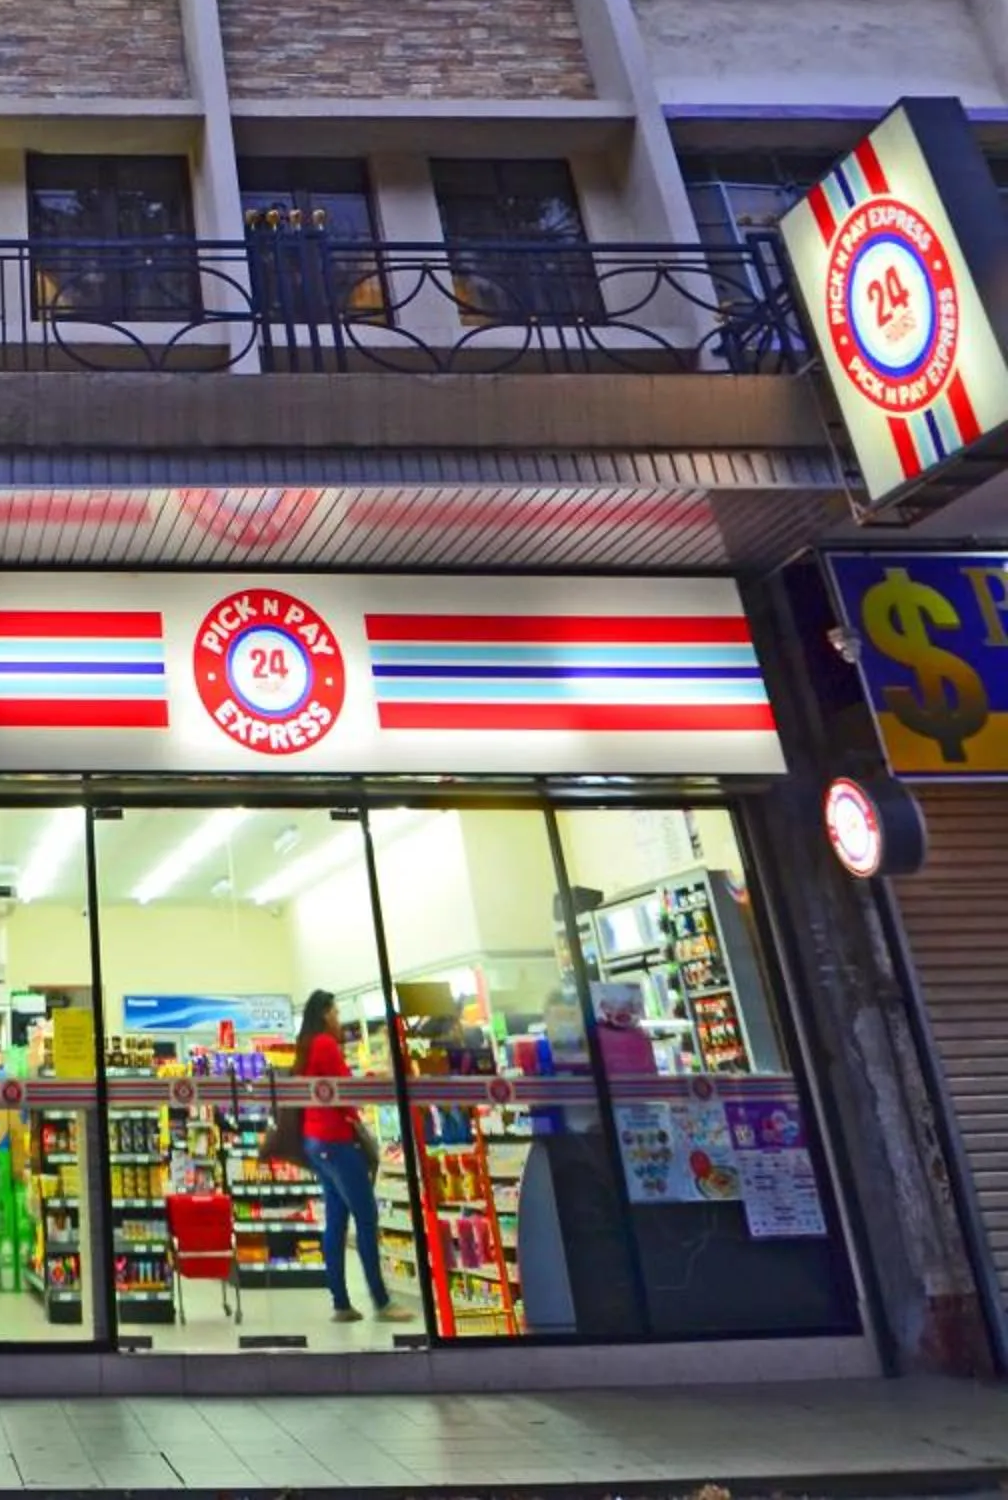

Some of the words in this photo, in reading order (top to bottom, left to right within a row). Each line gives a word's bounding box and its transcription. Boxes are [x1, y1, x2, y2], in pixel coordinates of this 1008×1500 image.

[829, 269, 846, 325] PICK
[843, 214, 867, 251] PAY
[868, 206, 932, 251] EXPRESS
[867, 265, 909, 328] 24
[847, 355, 885, 400] PICK
[898, 376, 929, 405] PAY
[926, 288, 955, 387] EXPRESS
[201, 595, 258, 655] PICK
[263, 598, 279, 617] N
[283, 605, 335, 656] PAY
[249, 648, 289, 679] 24
[214, 699, 332, 749] EXPRESS
